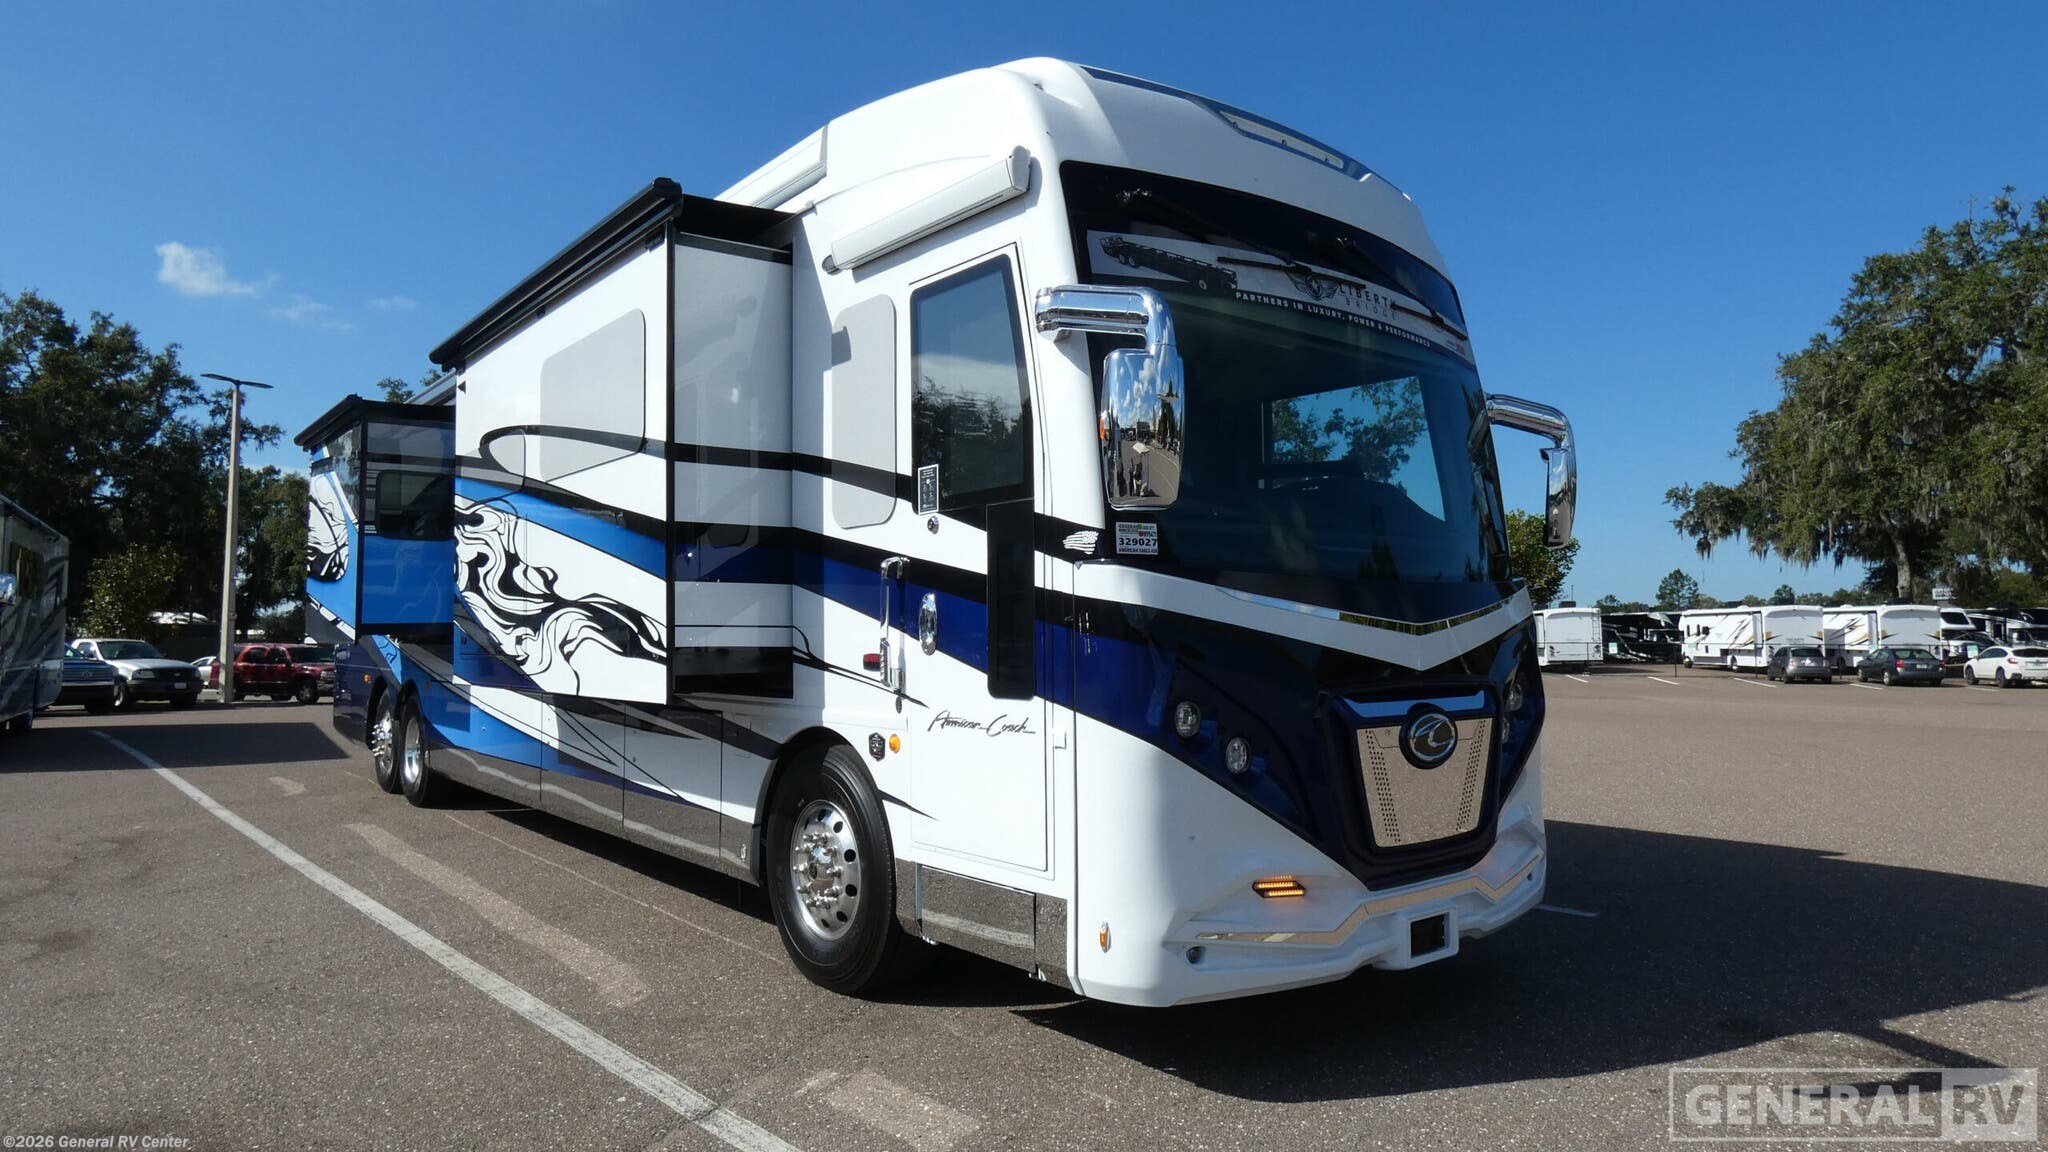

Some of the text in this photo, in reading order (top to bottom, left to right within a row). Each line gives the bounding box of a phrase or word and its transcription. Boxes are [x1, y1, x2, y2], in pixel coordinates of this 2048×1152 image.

[1235, 291, 1289, 308] PARTNERS
[1293, 302, 1303, 311] IN
[1307, 305, 1346, 321] LUXURY,
[1348, 314, 1375, 328] POWER
[1377, 323, 1383, 331] &
[1385, 326, 1431, 348] PERFORMANCE
[1345, 297, 1397, 320] BRIDGE
[1119, 537, 1157, 547] 329027
[927, 709, 1036, 737] American Coach
